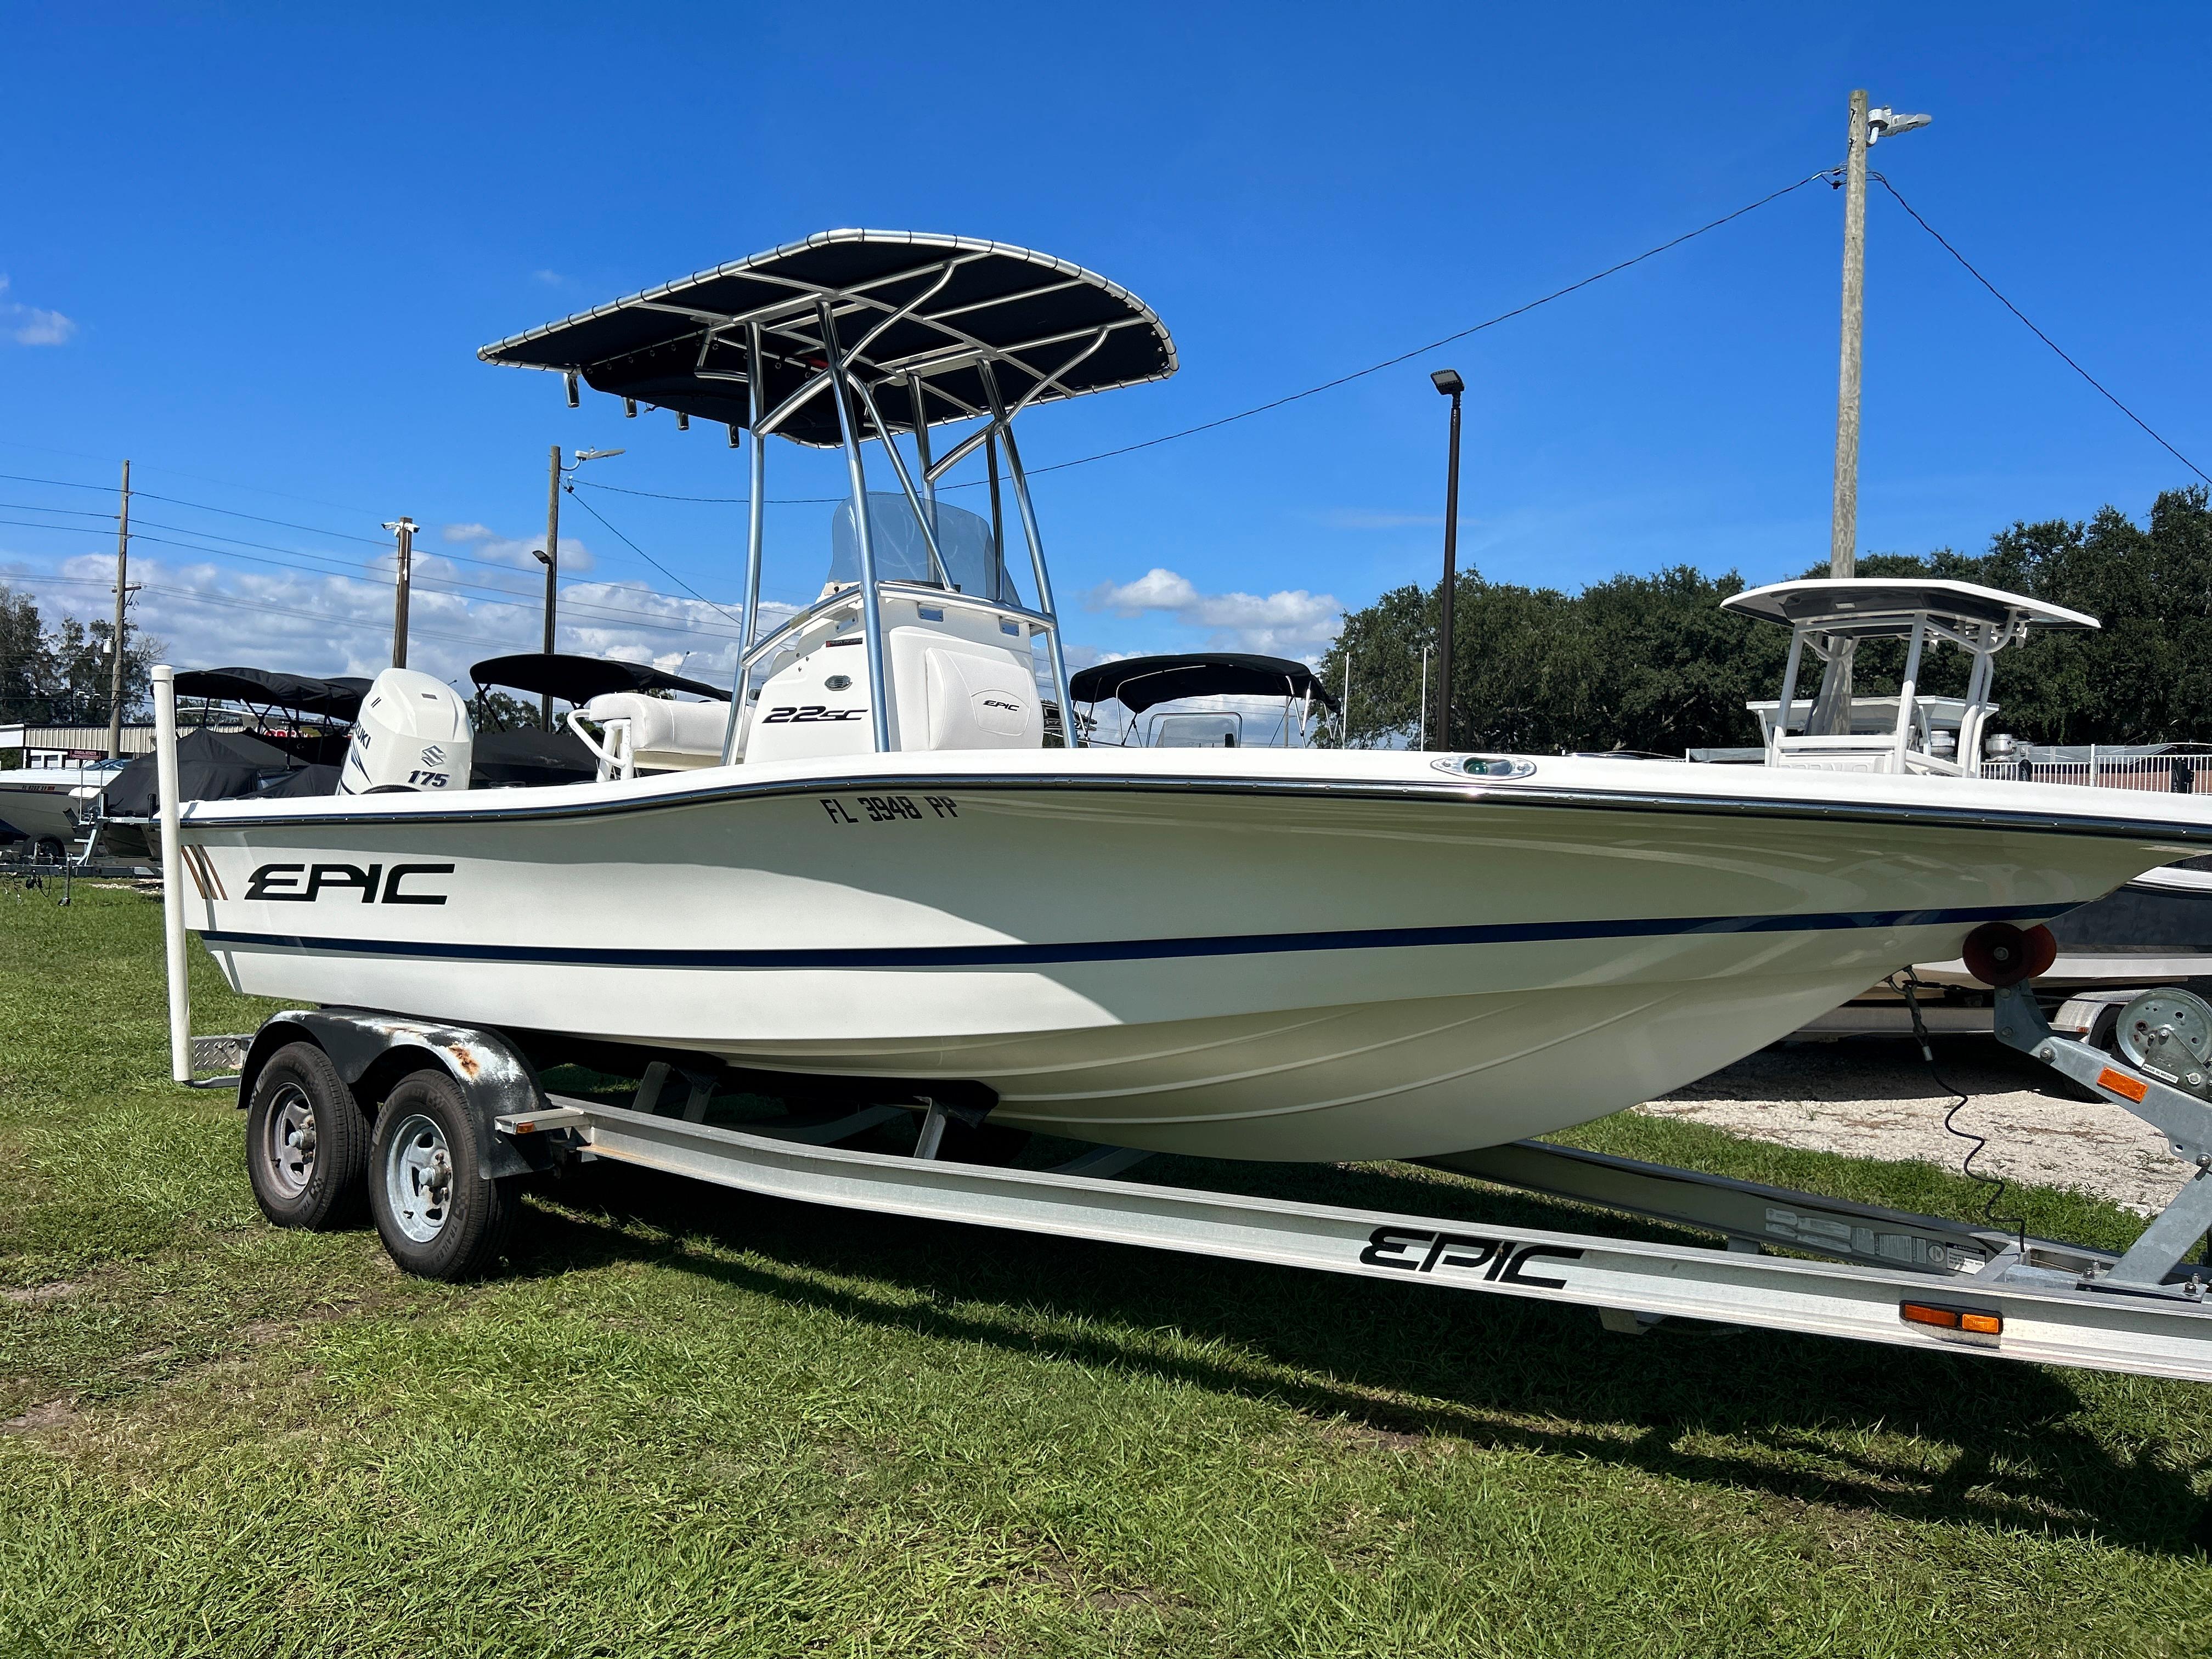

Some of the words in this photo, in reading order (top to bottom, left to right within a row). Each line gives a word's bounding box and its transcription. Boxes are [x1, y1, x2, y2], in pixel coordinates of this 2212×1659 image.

[983, 700, 1019, 712] EPIC
[356, 719, 371, 749] ZUKI
[408, 770, 450, 787] 175
[820, 799, 859, 823] FL
[857, 796, 923, 821] 3948
[923, 796, 958, 818] PP
[244, 864, 455, 905] EPIC
[1359, 1226, 1585, 1290] EPIC
